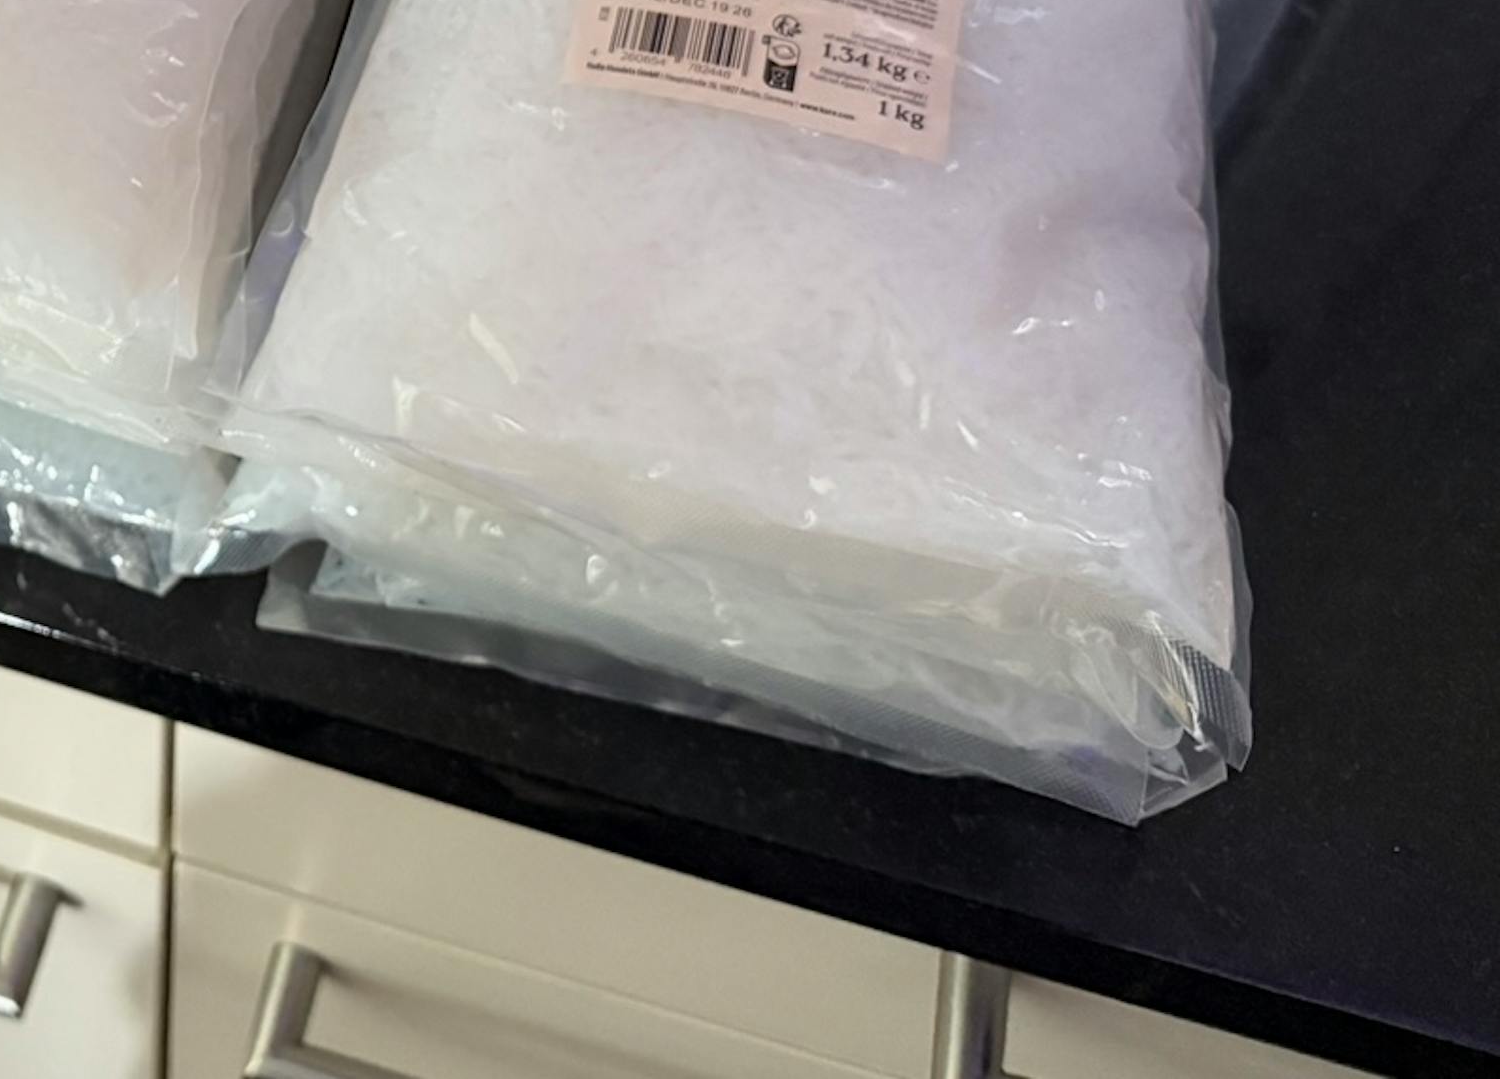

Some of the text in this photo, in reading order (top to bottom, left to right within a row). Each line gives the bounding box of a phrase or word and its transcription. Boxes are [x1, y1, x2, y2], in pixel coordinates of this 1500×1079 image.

[711, 0, 729, 14] 19
[876, 55, 908, 83] kg
[878, 100, 925, 131] 1 kg
